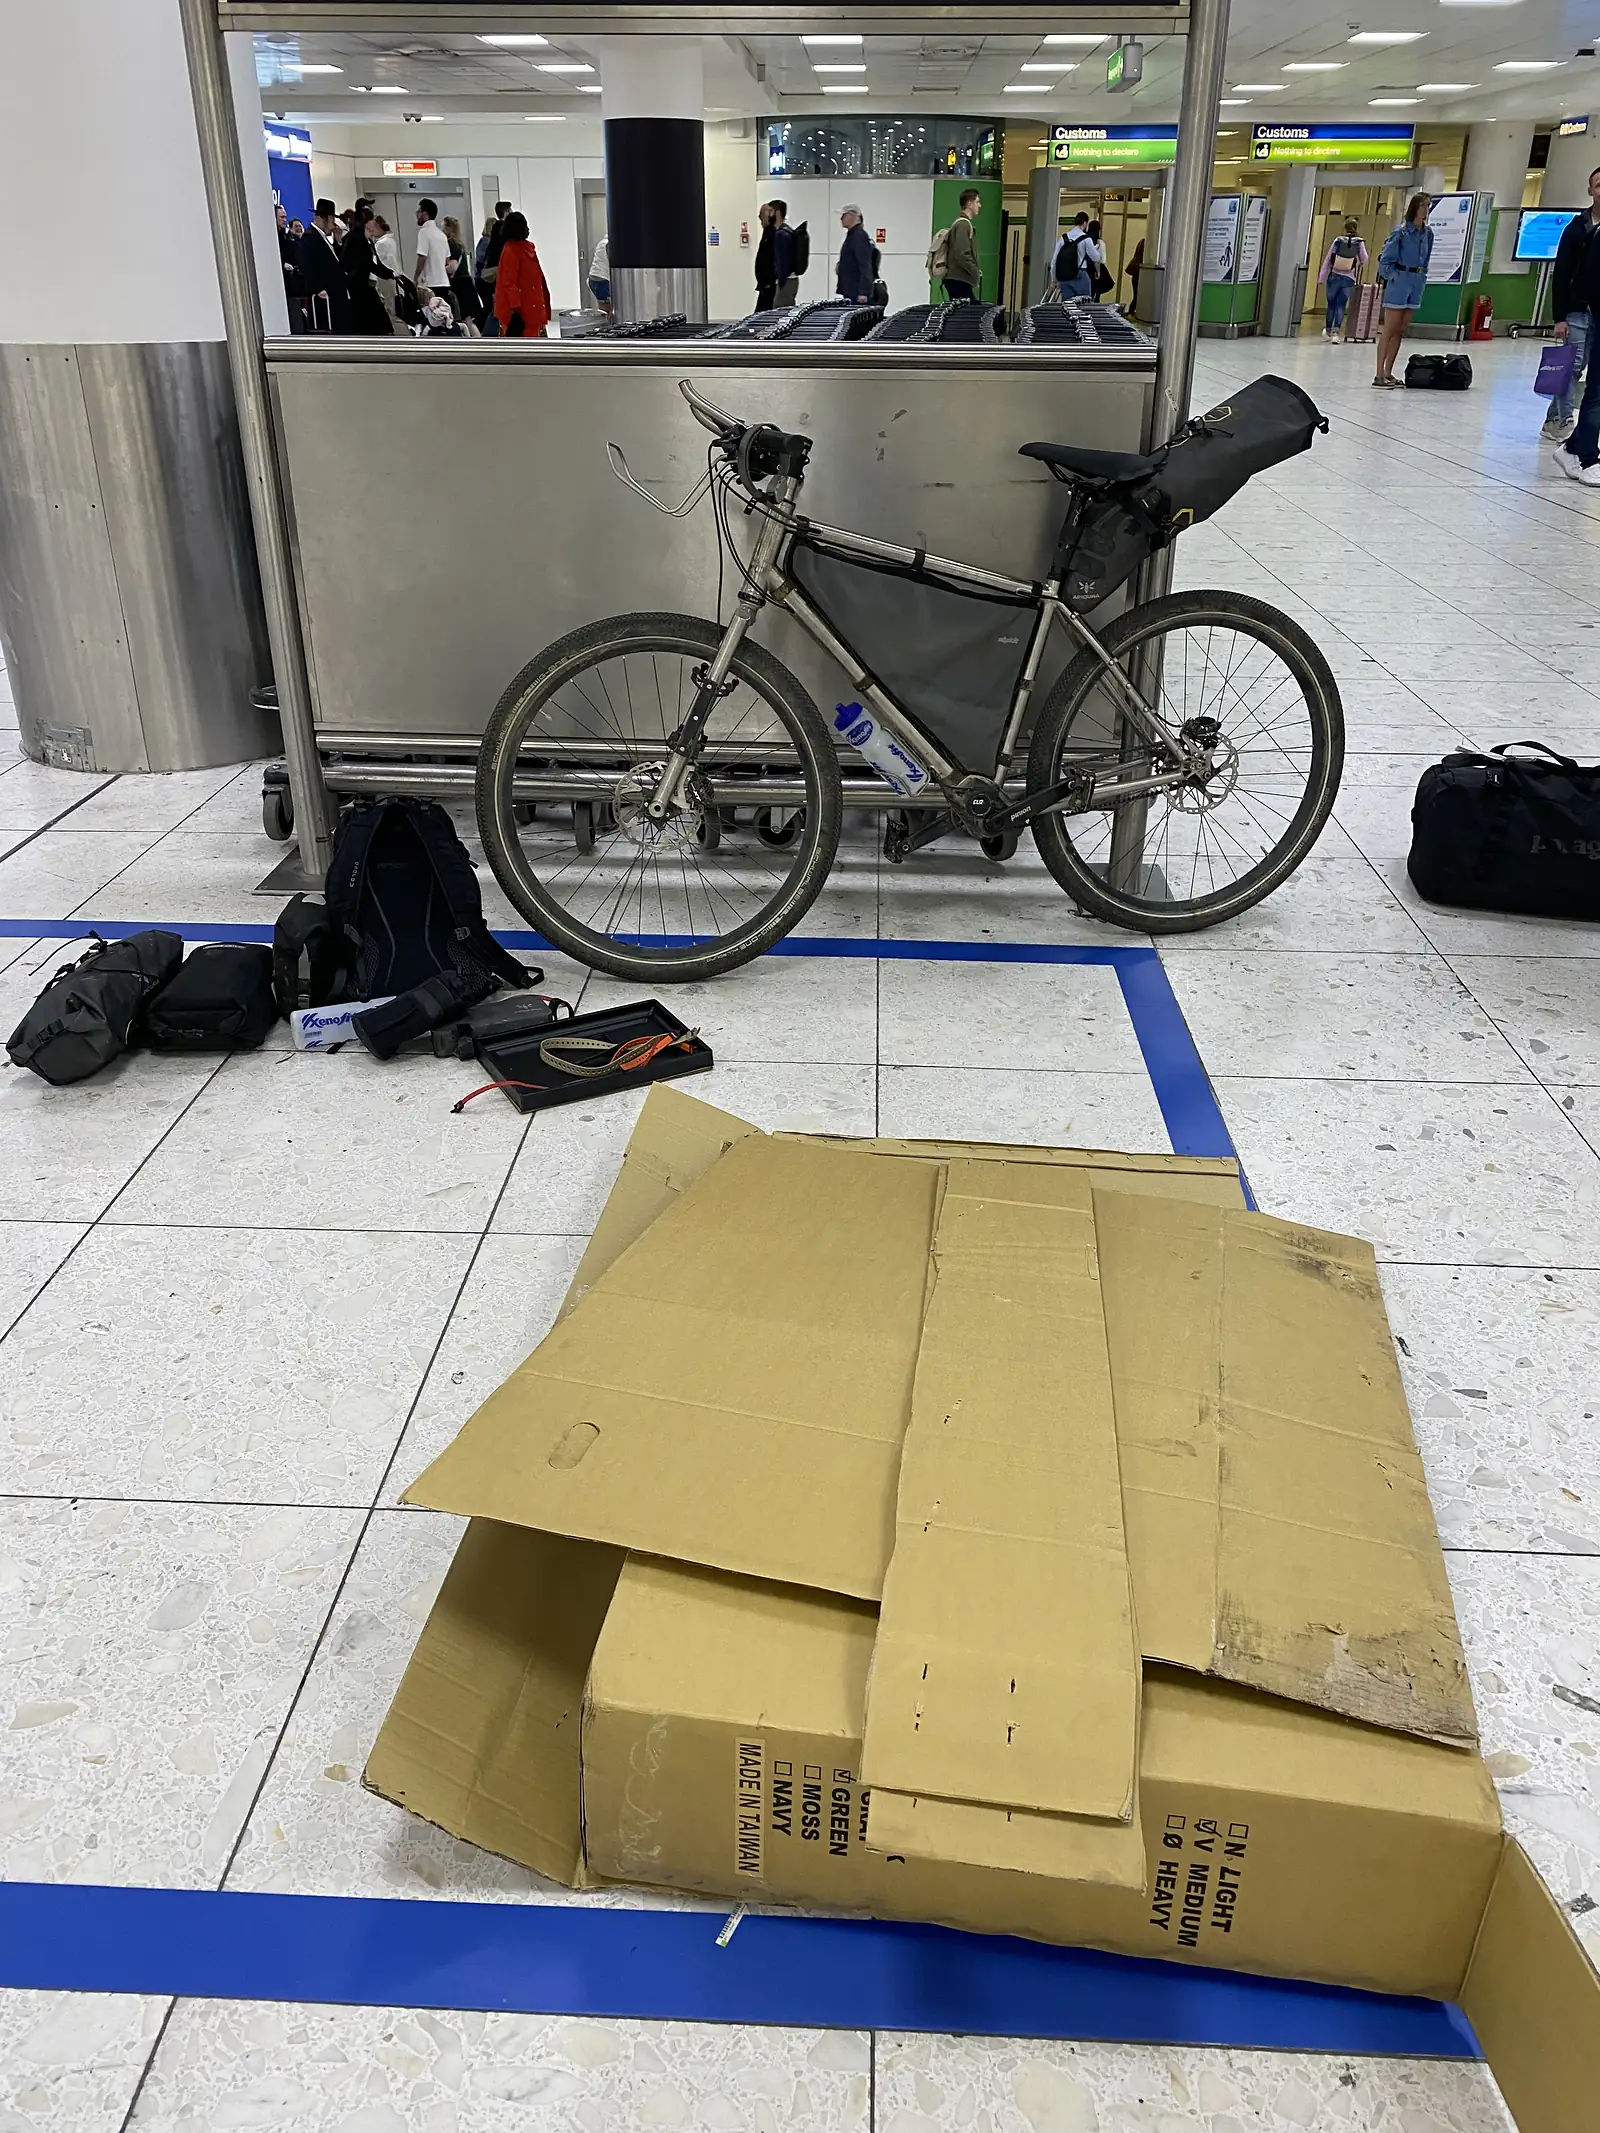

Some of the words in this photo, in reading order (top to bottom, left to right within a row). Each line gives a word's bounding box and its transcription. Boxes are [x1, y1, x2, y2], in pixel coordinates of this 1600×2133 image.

[1055, 127, 1107, 139] Customs
[1257, 126, 1309, 138] Customs
[1073, 148, 1102, 157] Nothing
[1103, 148, 1111, 156] to
[1112, 148, 1139, 156] declare
[1274, 147, 1302, 156] Nothing
[1304, 147, 1312, 155] to
[1313, 147, 1340, 155] declare
[888, 743, 922, 779] Xenofit
[1010, 805, 1032, 822] pinion
[302, 1012, 355, 1030] Xenofi
[739, 1743, 761, 1790] MADE
[739, 1793, 761, 1809] IN
[772, 1780, 792, 1836] NAVY
[801, 1783, 821, 1841] MOSS
[829, 1787, 851, 1857] GREEN
[739, 1814, 760, 1872] TAIWAN
[1193, 1838, 1215, 1853] V
[1224, 1841, 1247, 1858] N
[1149, 1860, 1179, 1931] HEAVY
[1177, 1863, 1210, 1947] MEDIUM
[1210, 1866, 1241, 1933] LIGHT
